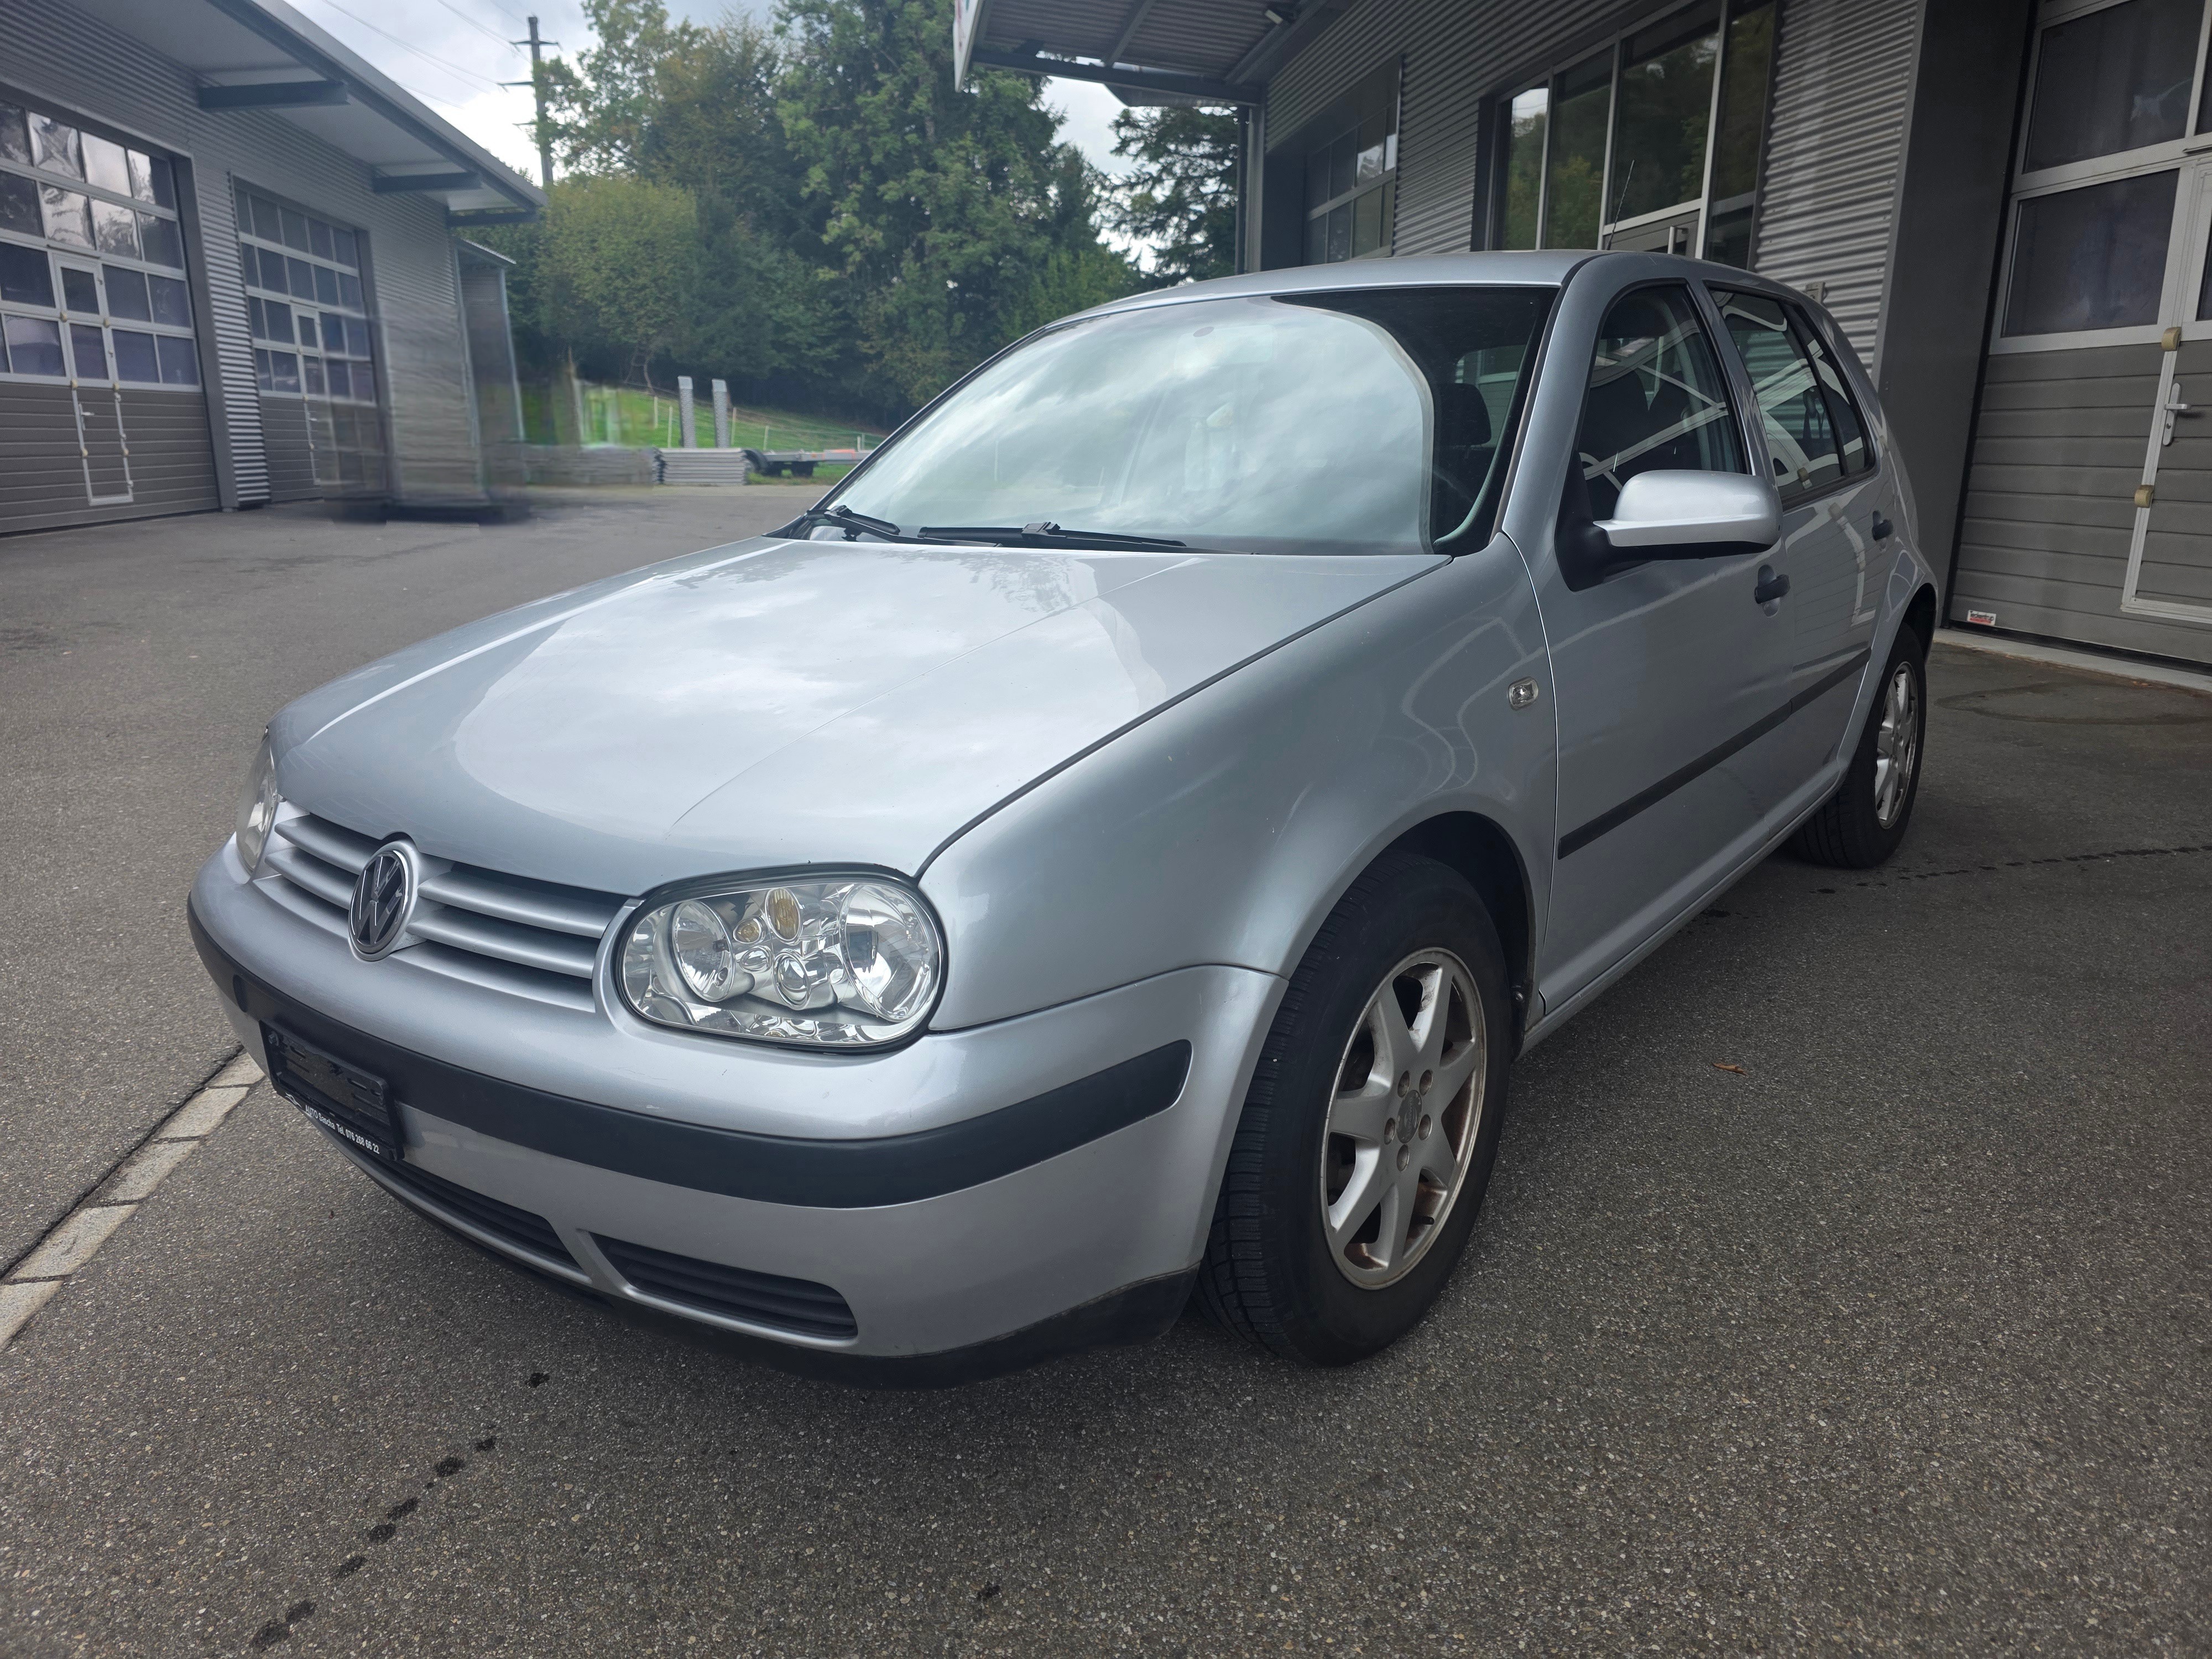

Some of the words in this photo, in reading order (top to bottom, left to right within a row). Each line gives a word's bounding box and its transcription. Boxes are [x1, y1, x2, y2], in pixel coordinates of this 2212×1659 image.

[305, 1104, 318, 1119] AUTO
[318, 1113, 336, 1130] Sascha
[336, 1123, 346, 1136] Tel.
[345, 1129, 355, 1141] 076
[355, 1134, 365, 1146] 268
[365, 1139, 372, 1150] 66
[372, 1143, 380, 1154] 22
